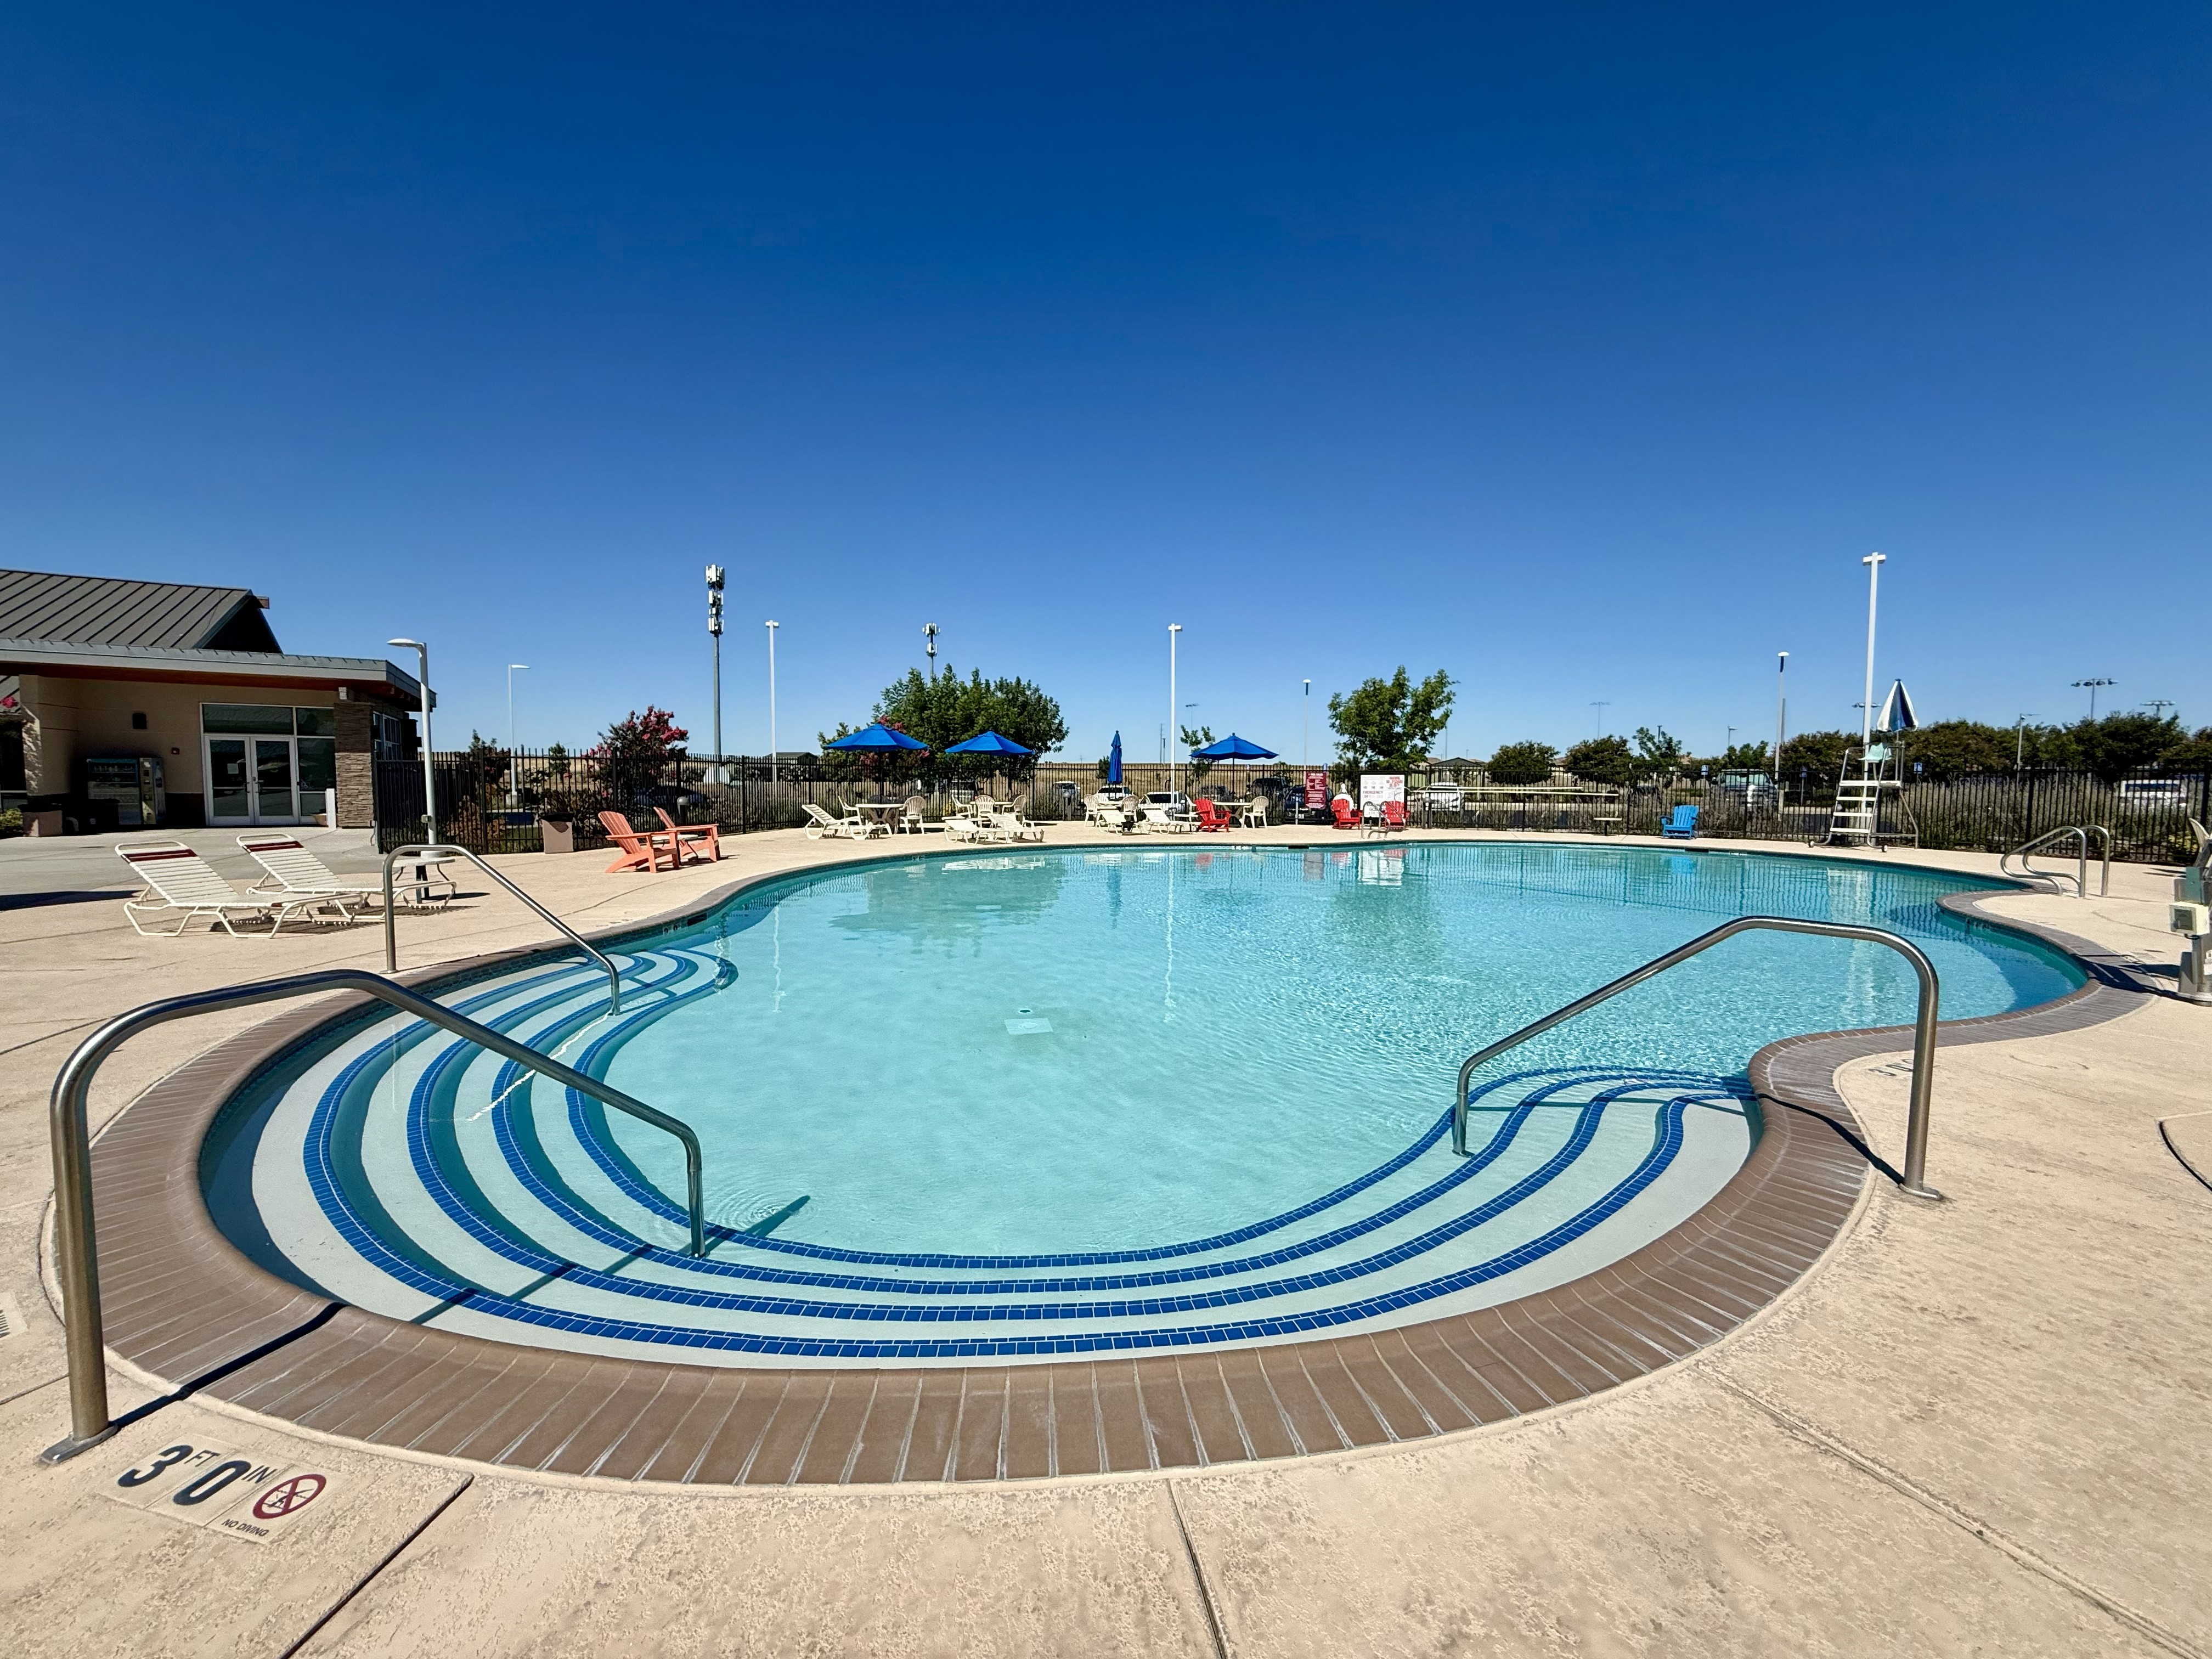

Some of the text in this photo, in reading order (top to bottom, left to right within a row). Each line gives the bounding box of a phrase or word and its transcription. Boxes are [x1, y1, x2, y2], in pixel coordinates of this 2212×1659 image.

[1867, 1068, 1897, 1076] 3
[118, 1444, 278, 1506] 3 FT 0 IN
[221, 1518, 270, 1537] NO DIVING
